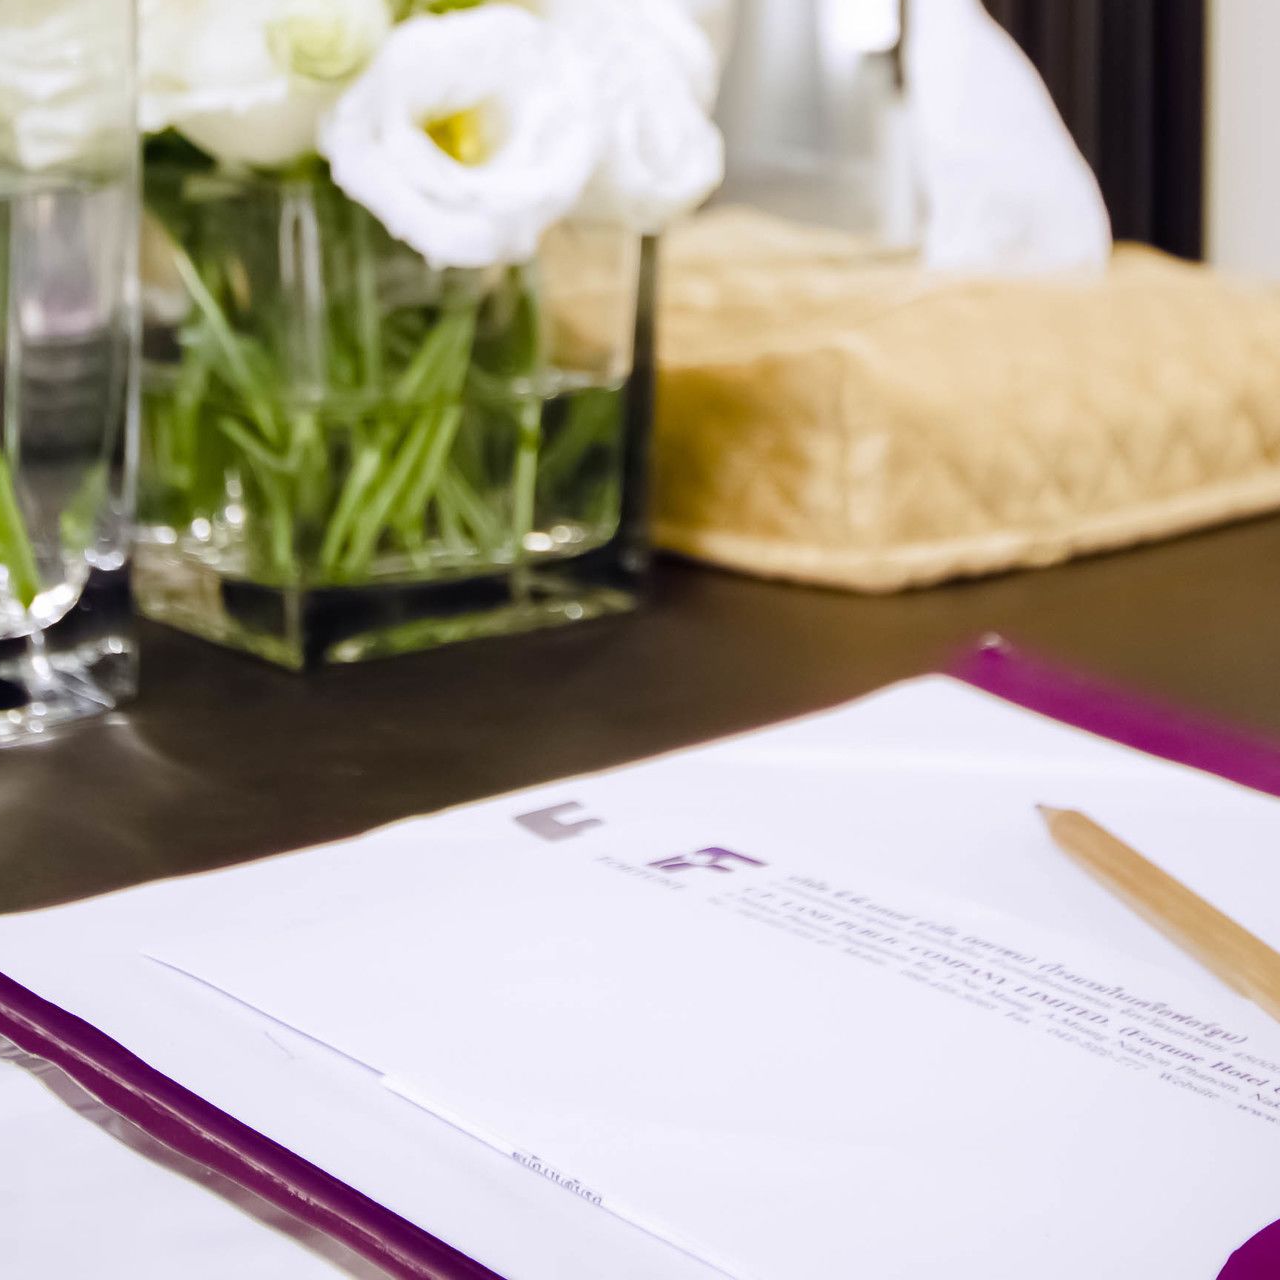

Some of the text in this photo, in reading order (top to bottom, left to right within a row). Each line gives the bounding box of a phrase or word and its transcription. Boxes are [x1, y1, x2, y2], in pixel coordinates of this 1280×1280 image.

[1014, 986, 1109, 1024] LIMITED
[1118, 1026, 1205, 1063] (Fortune
[1210, 1061, 1270, 1087] Hotel
